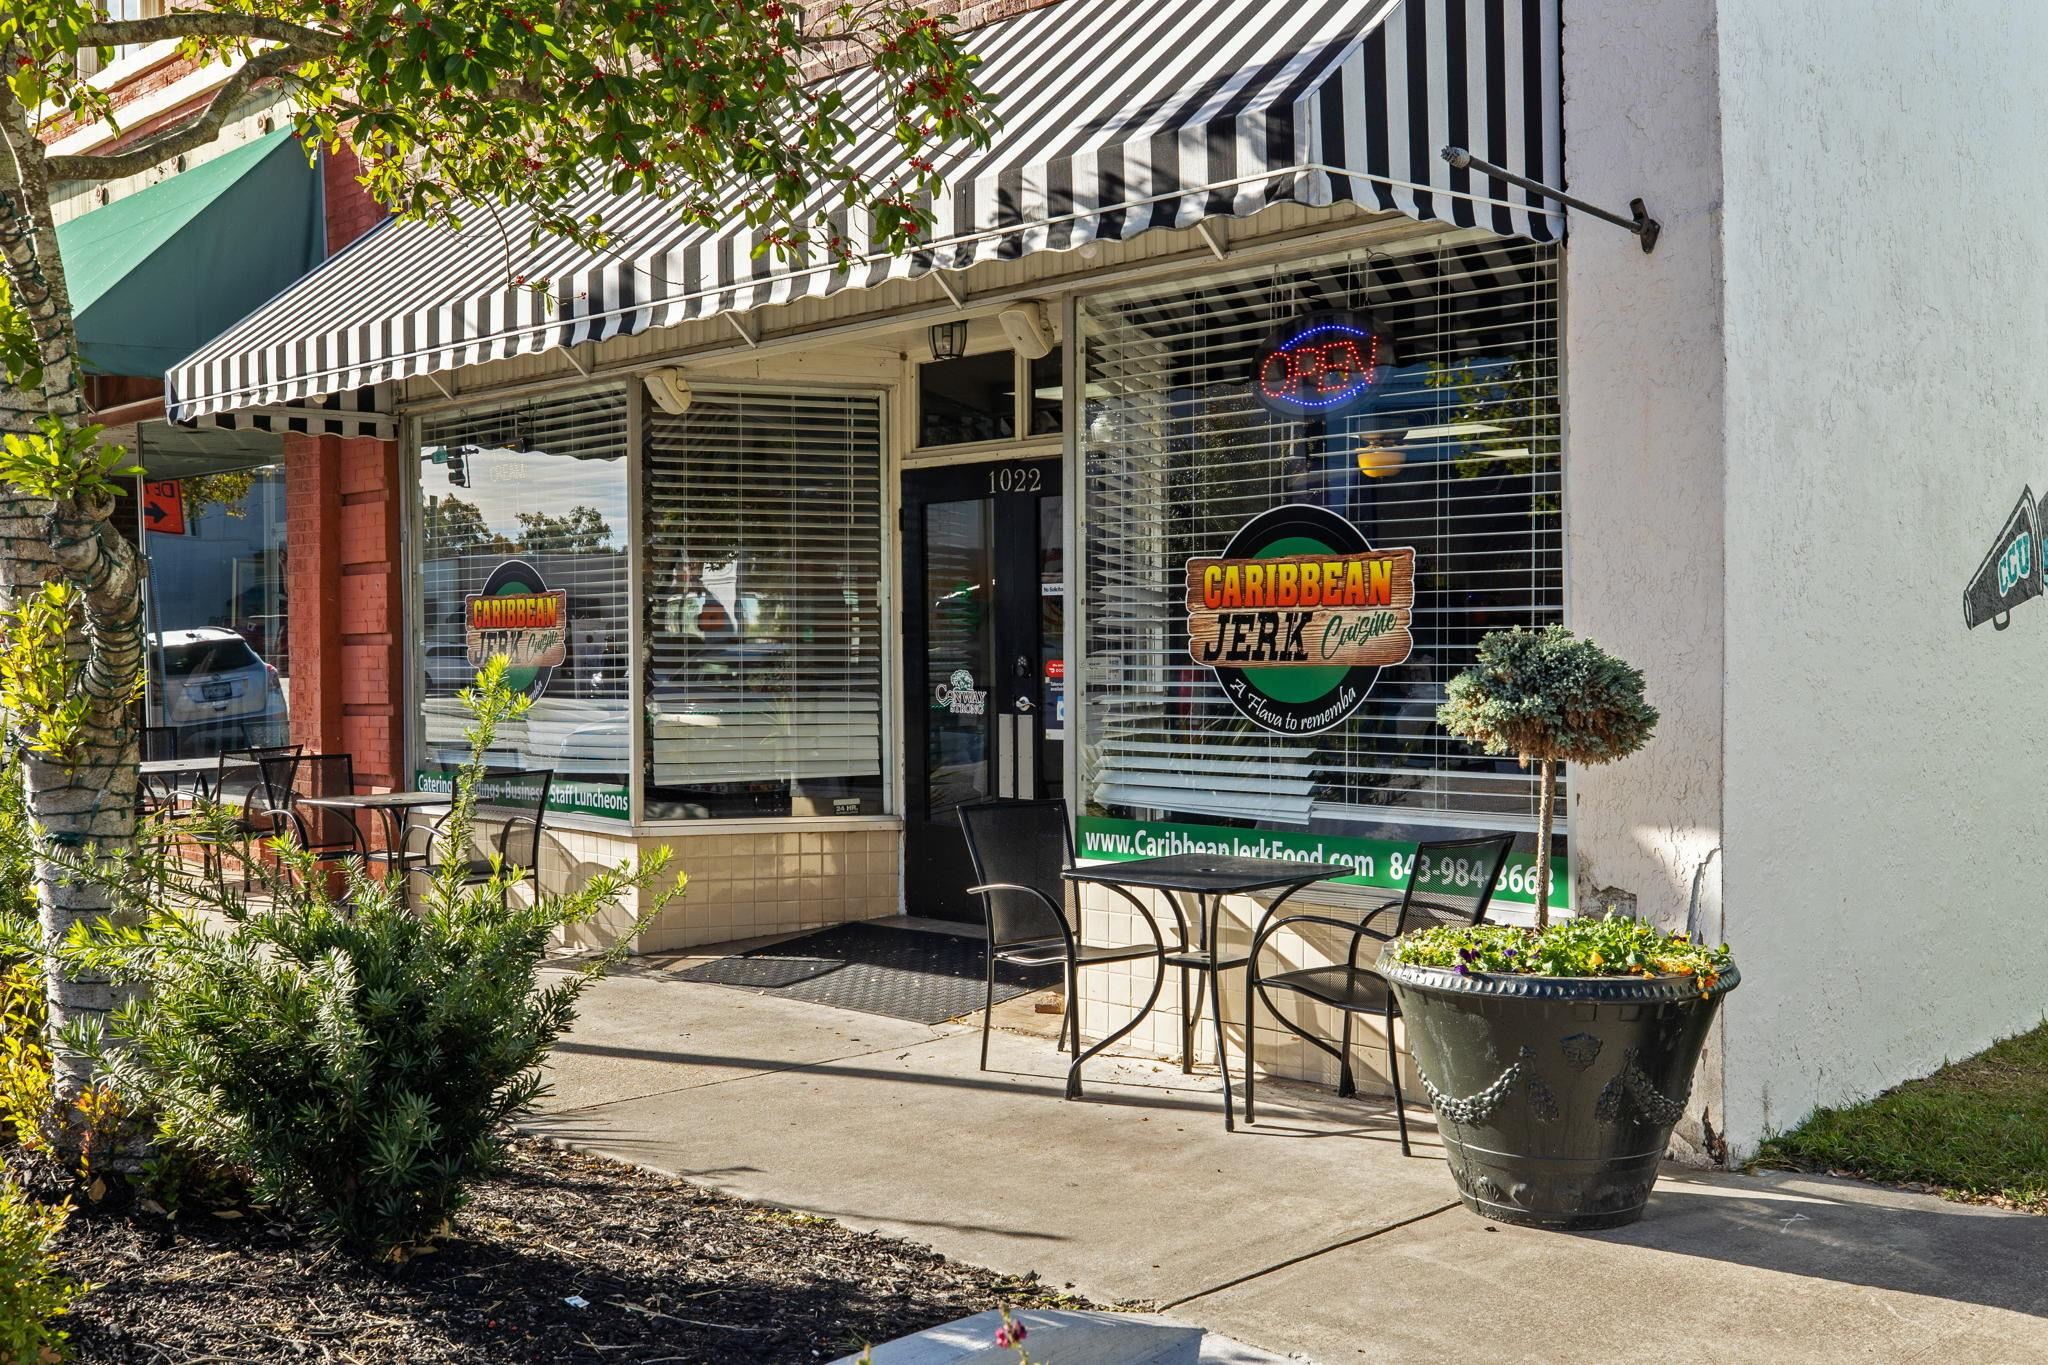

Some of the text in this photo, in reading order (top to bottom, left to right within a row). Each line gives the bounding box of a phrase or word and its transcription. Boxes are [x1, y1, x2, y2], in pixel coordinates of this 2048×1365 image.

[1260, 335, 1378, 397] OPEN
[988, 468, 1041, 494] 1022
[1203, 559, 1393, 609] CARIBBEAN
[1998, 532, 2031, 598] CCU
[473, 596, 558, 629] CARIBBEAN
[1203, 611, 1398, 661] JERK Cuisine
[474, 631, 523, 664] JERK
[950, 703, 984, 714] STRONG
[1229, 678, 1357, 730] A Flava to rememba
[505, 780, 544, 801] Business
[550, 784, 573, 804] Staff
[575, 789, 628, 811] Luncheons
[1085, 829, 1374, 878] www.CaribbeanJerkFoodcom
